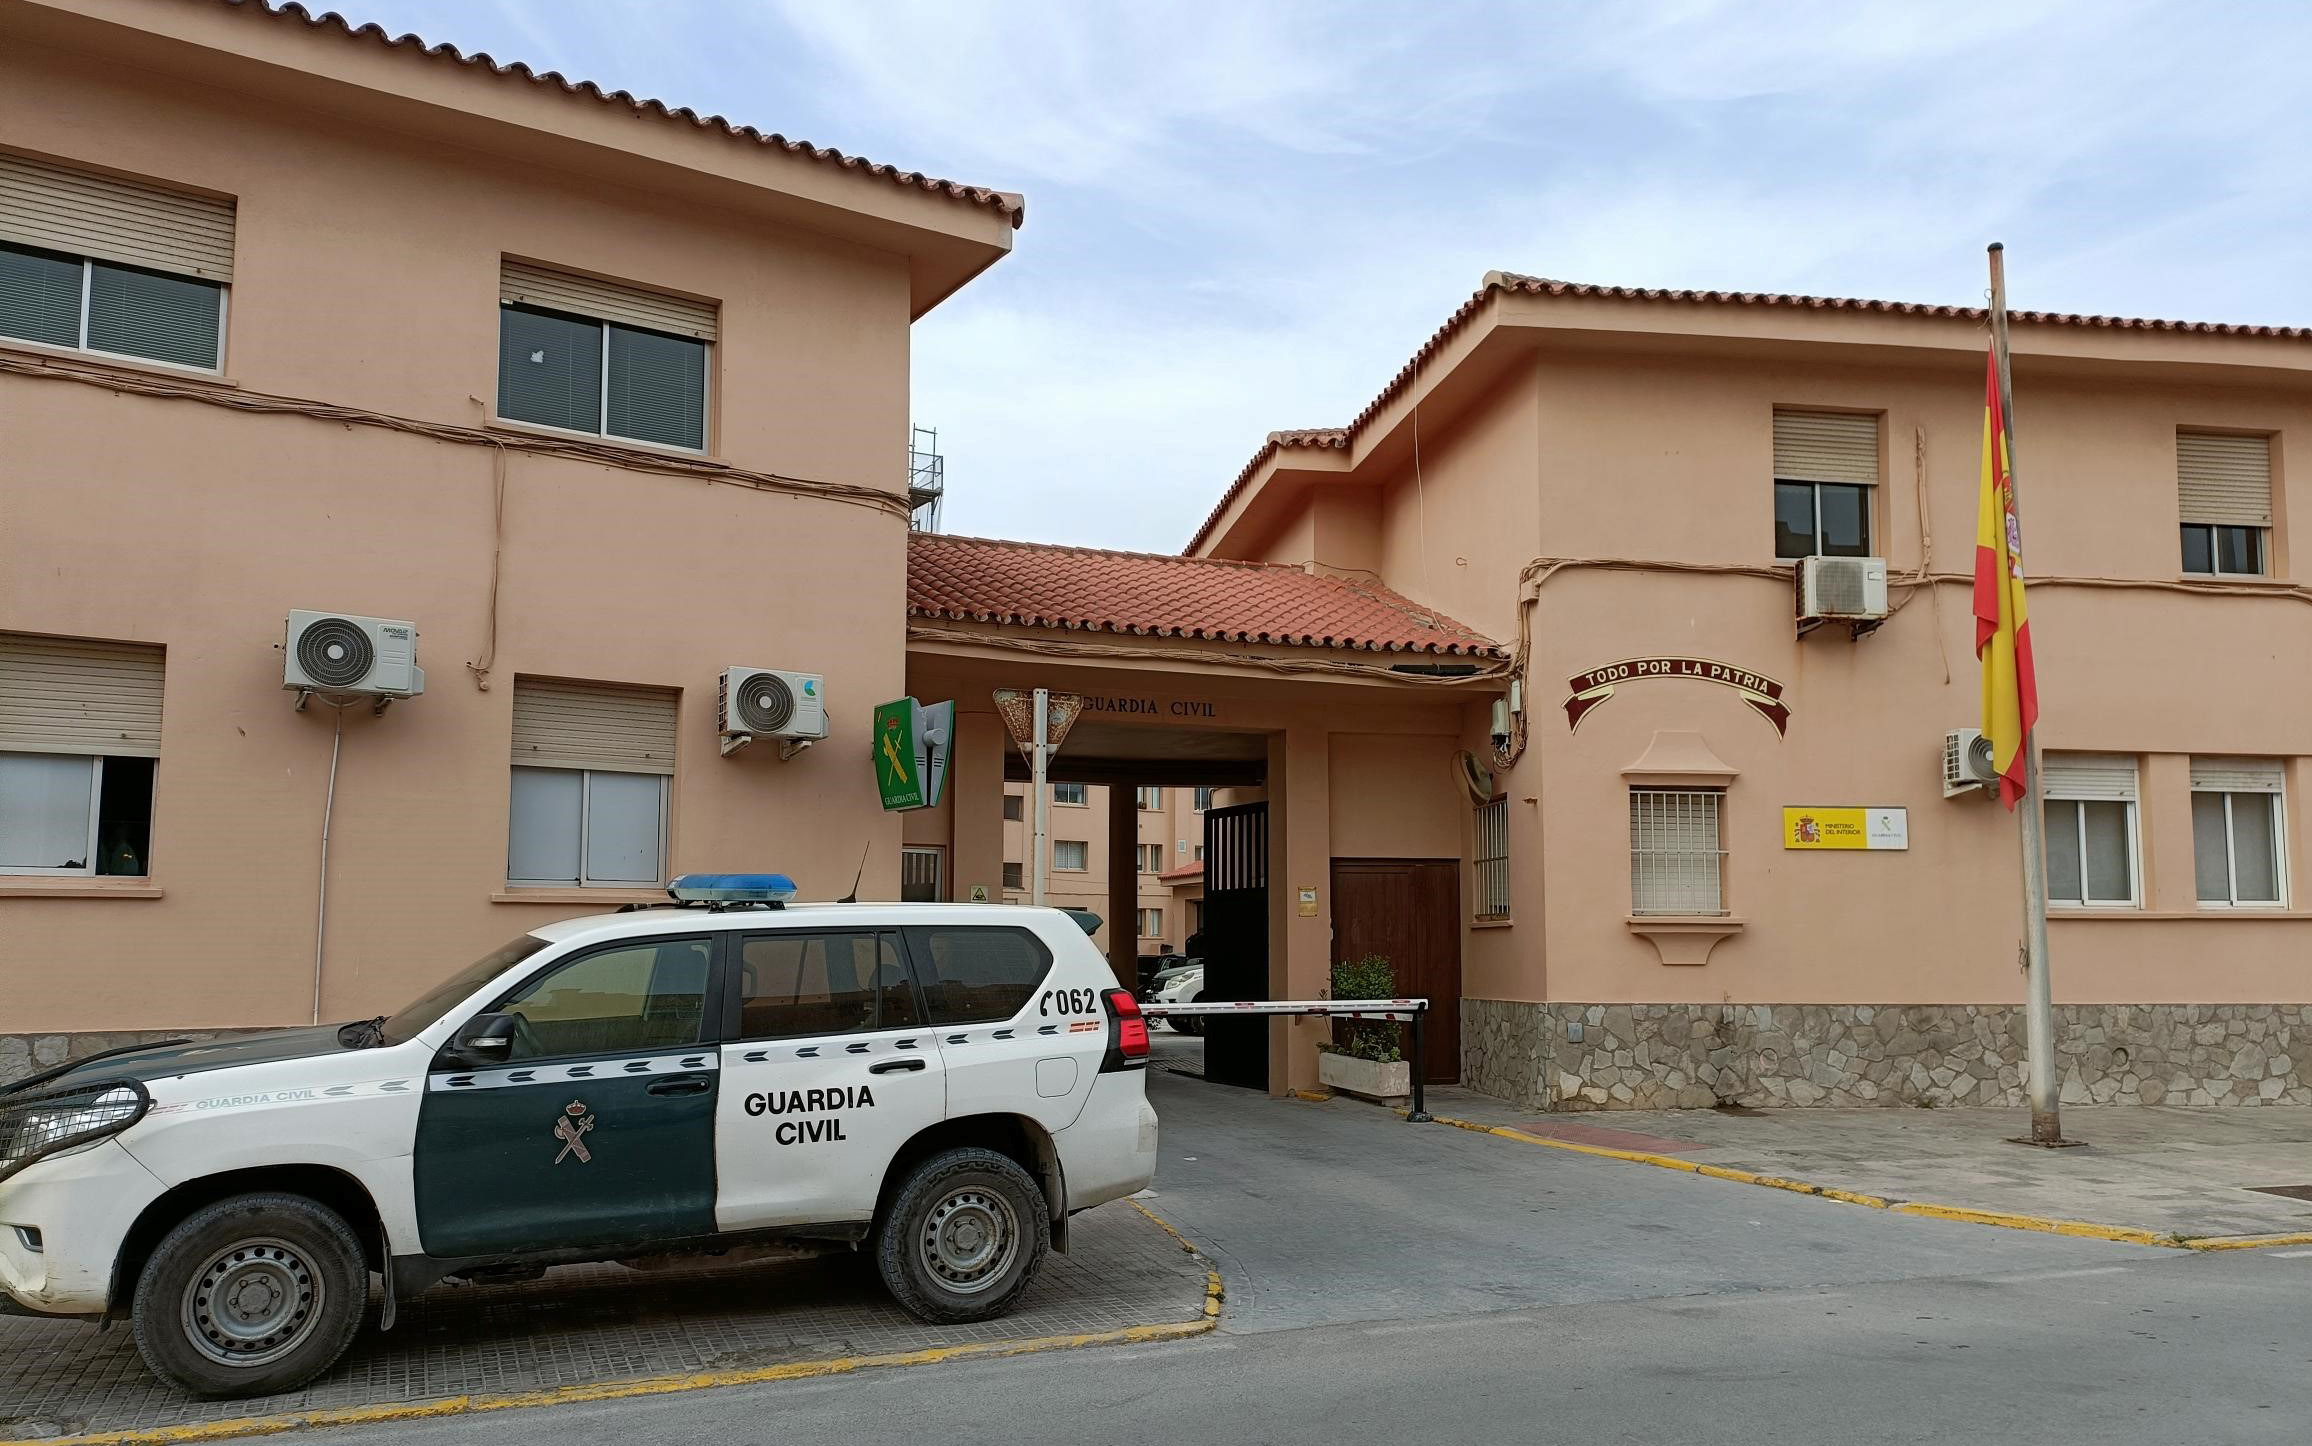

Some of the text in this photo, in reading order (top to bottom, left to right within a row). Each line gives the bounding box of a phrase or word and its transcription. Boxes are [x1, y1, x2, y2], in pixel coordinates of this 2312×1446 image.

[1586, 661, 1769, 694] TODO POR LA PATRIA
[1081, 696, 1216, 717] GUARDIA CIVIL
[1056, 988, 1097, 1015] 062
[196, 1090, 316, 1109] GUARDIA CIVIL
[744, 1085, 875, 1117] GUARDIA
[775, 1118, 847, 1146] CIVIL
